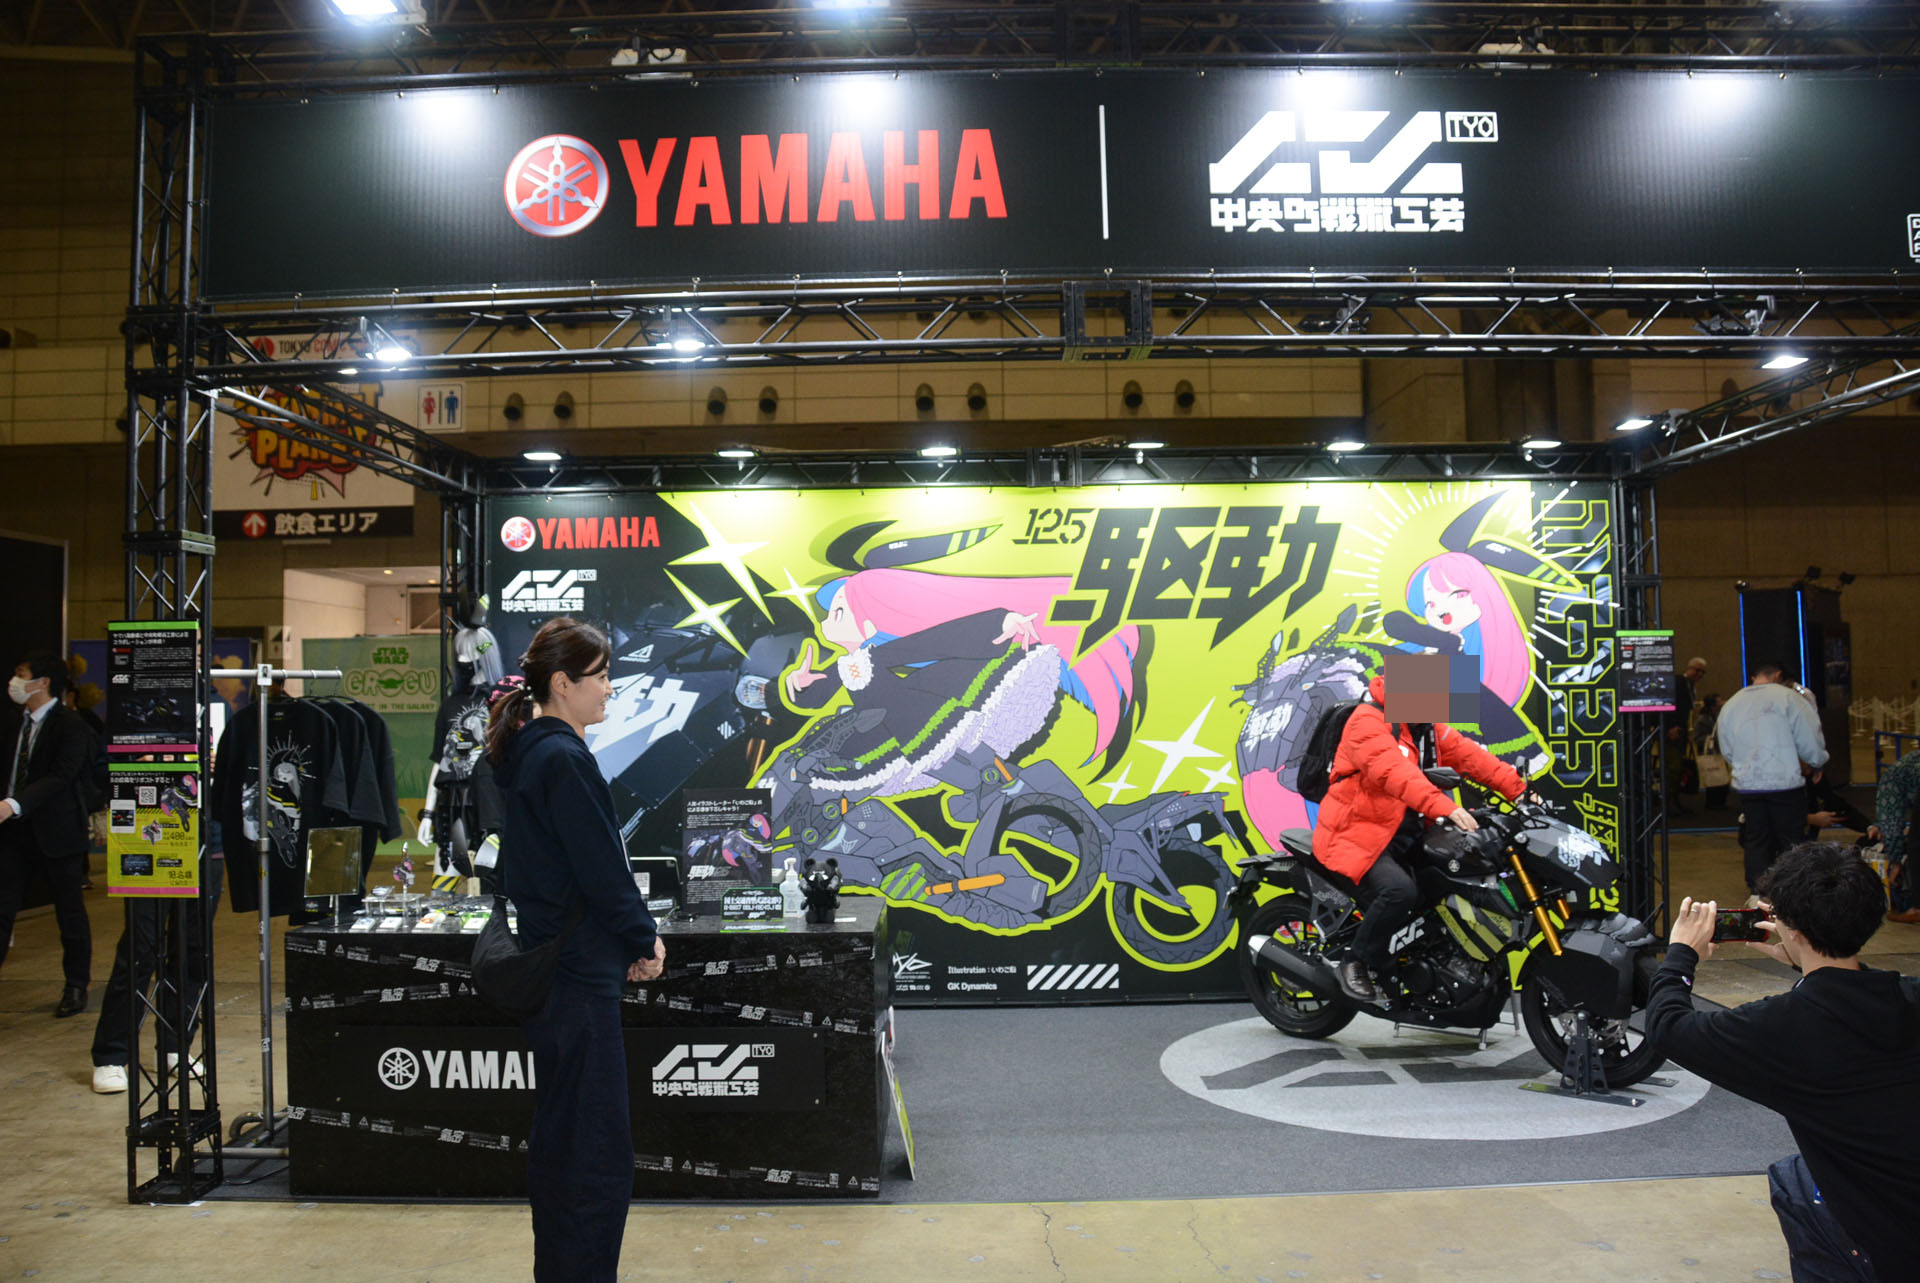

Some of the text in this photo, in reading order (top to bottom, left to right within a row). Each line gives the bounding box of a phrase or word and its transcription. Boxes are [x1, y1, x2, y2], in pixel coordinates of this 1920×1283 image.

[1449, 115, 1494, 138] TYO
[619, 128, 1007, 227] YAMAHA
[275, 512, 378, 535] 飲食エリア
[536, 516, 661, 549] YAMAHA
[1012, 507, 1095, 544] 125
[1050, 505, 1342, 657] 駆動
[372, 655, 409, 665] WARS
[376, 647, 409, 658] STAR
[947, 982, 998, 992] GK Dynamics
[753, 1045, 773, 1056] TYO
